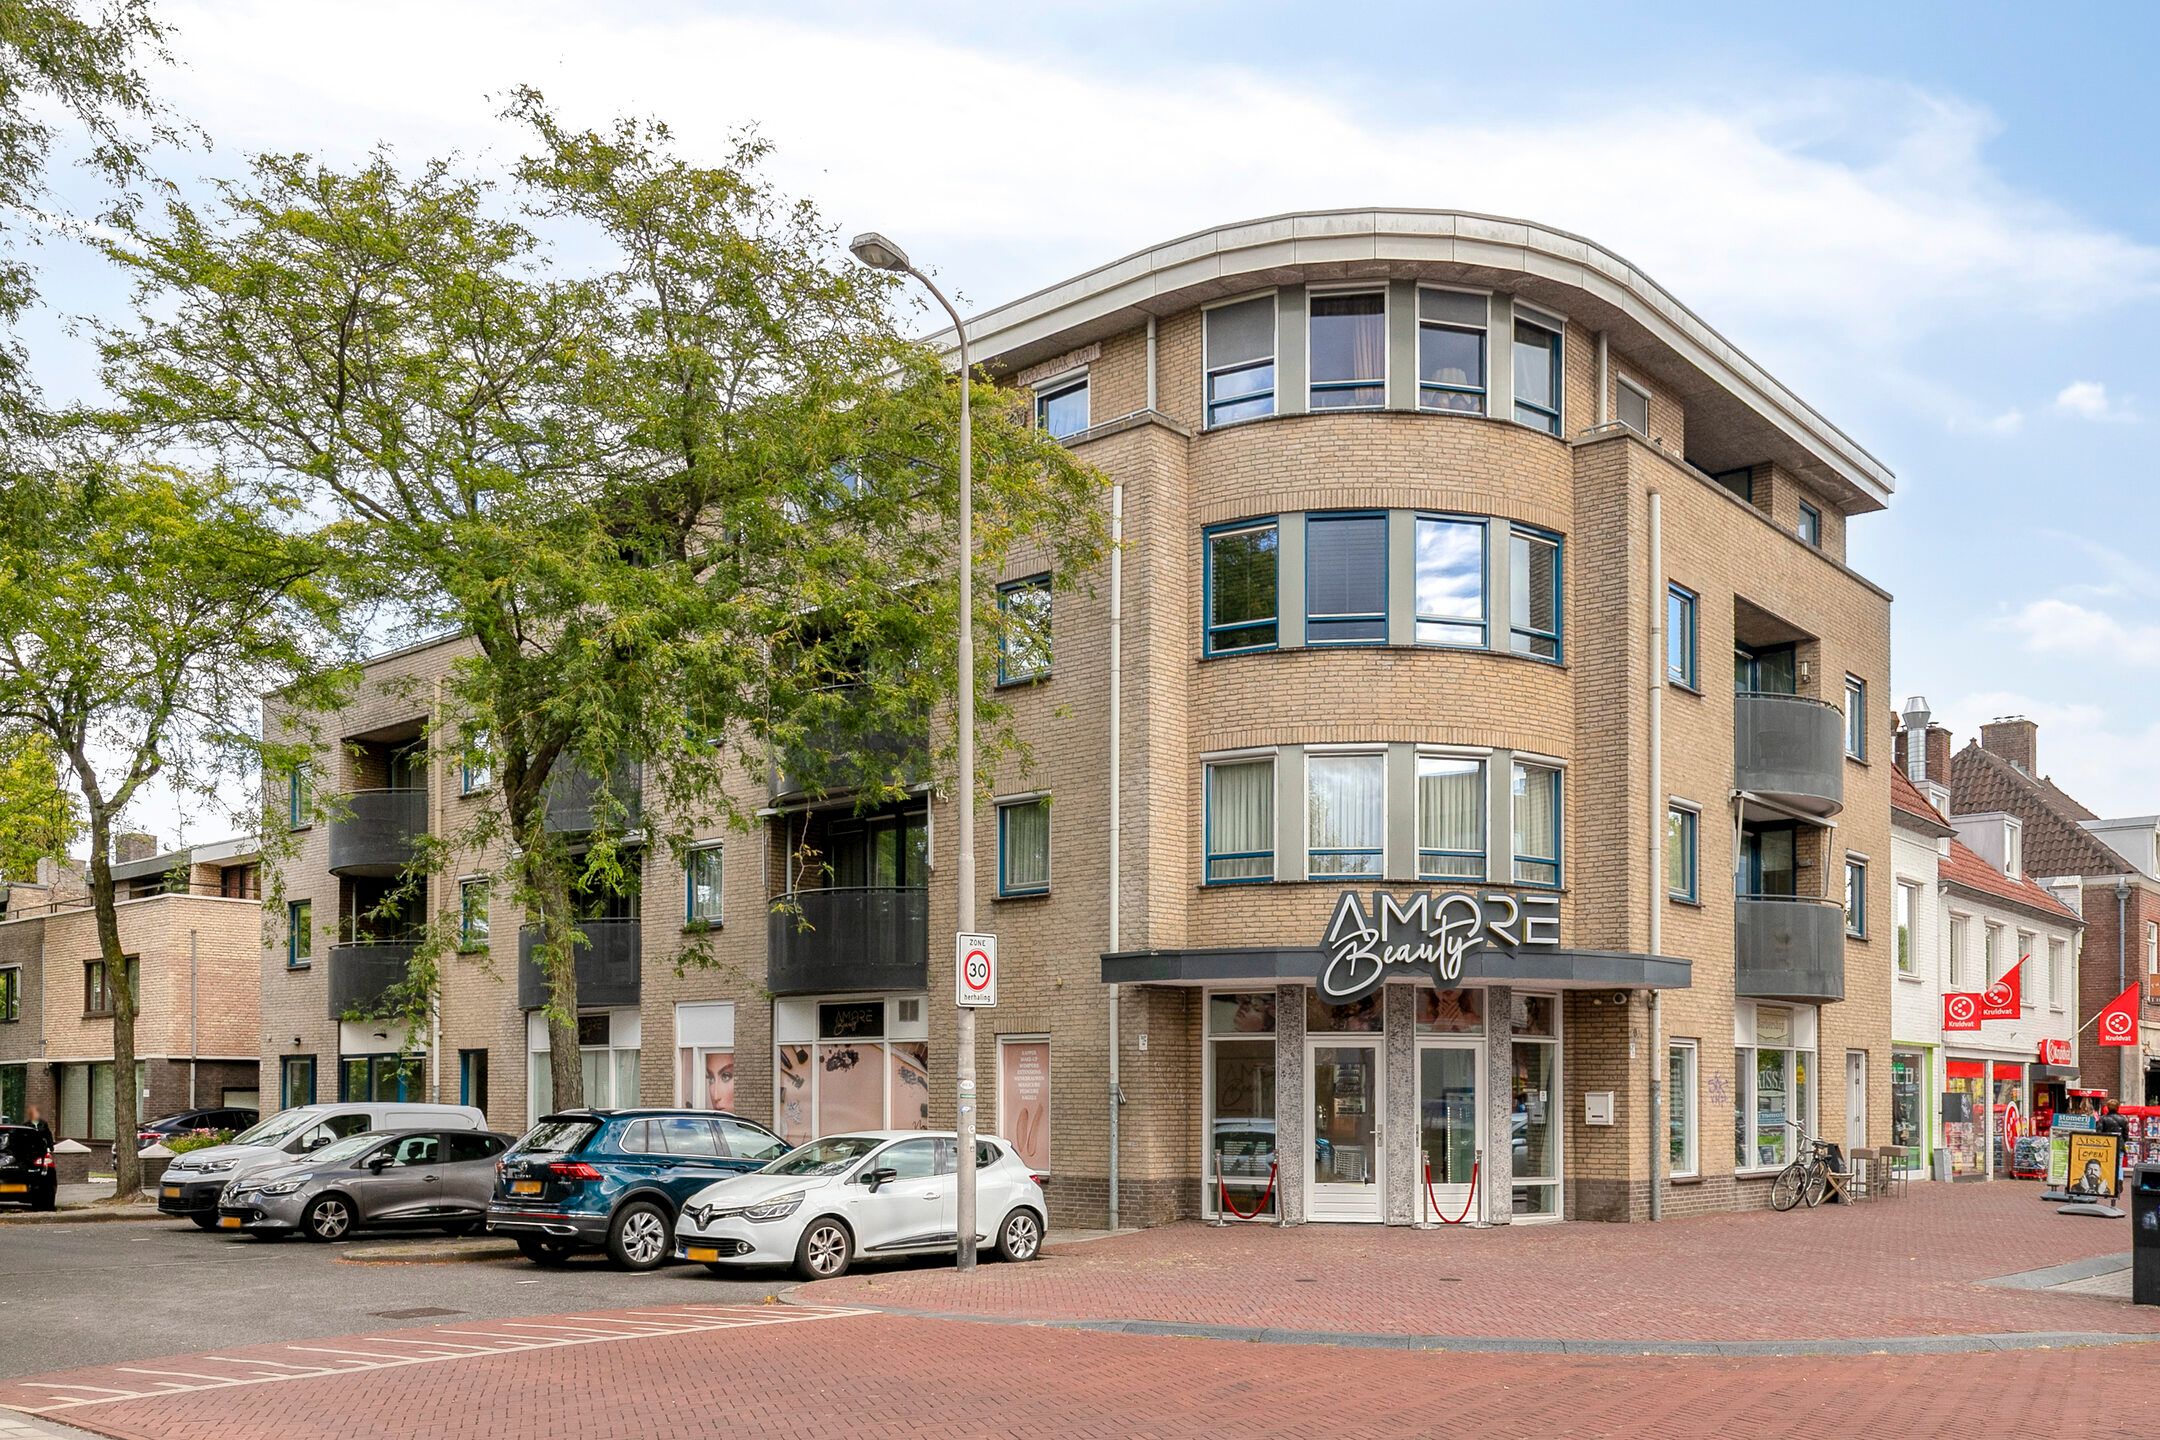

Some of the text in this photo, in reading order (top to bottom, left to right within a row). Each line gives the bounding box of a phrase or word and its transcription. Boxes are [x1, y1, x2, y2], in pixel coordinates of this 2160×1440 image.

[1328, 894, 1559, 947] AMORE
[969, 938, 986, 947] ZONE
[1323, 915, 1484, 996] Beauty
[968, 962, 987, 978] 30
[964, 993, 991, 1003] herhaling
[835, 1010, 873, 1024] AMORE
[1983, 1008, 2013, 1016] Kruidvat
[1948, 1020, 1975, 1028] Kruidvat
[2105, 1034, 2132, 1042] Kruidvat
[2077, 1136, 2111, 1146] AISSA
[2081, 1150, 2104, 1158] OPEN
